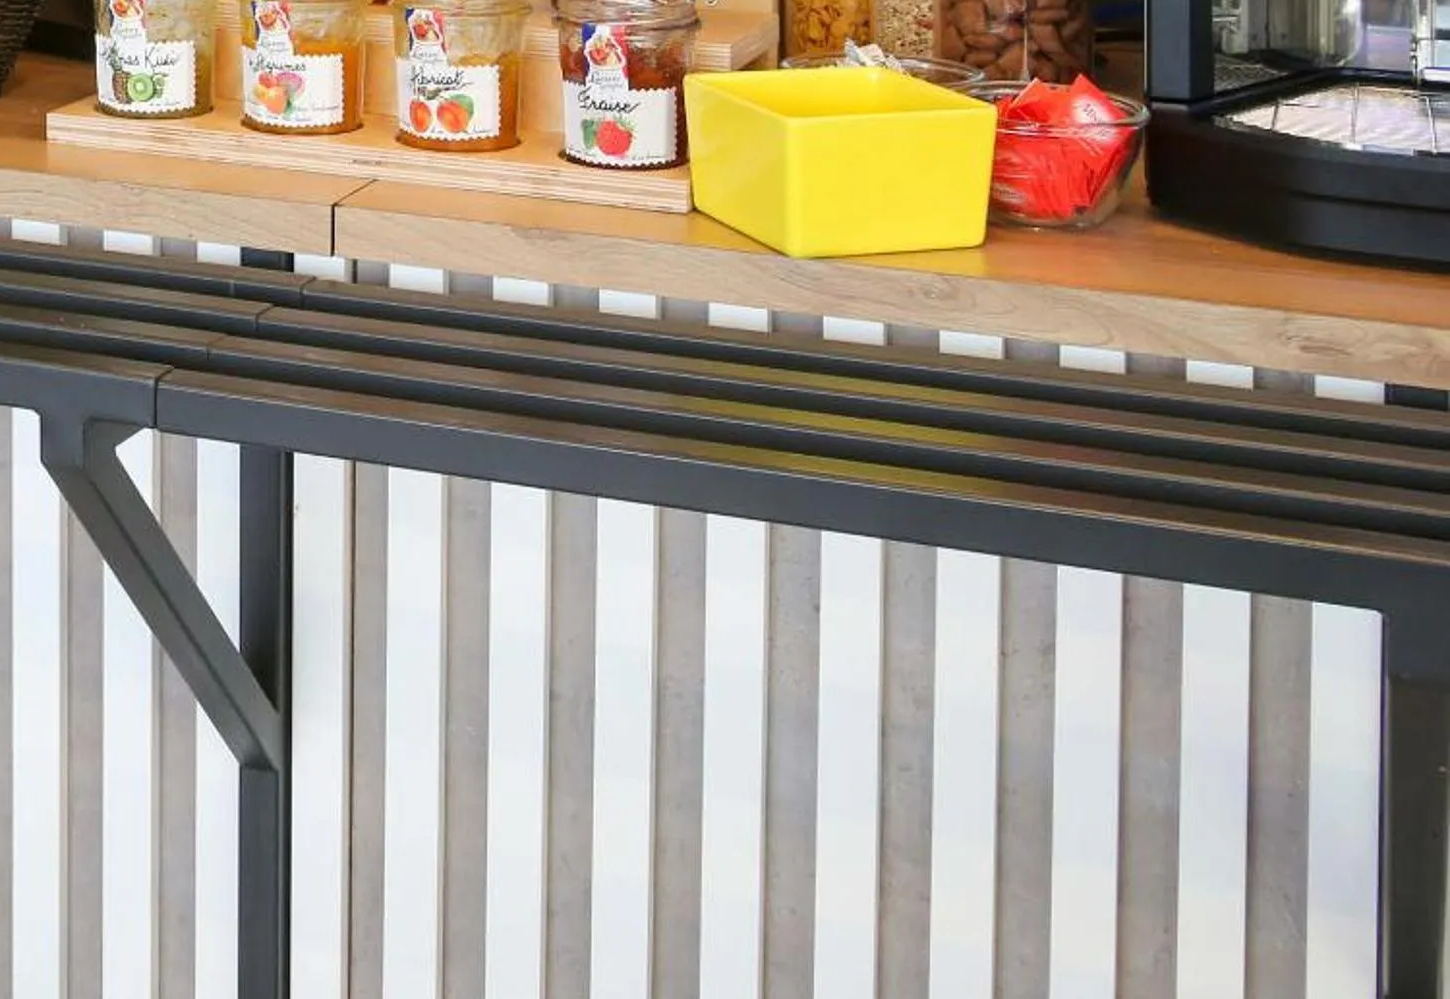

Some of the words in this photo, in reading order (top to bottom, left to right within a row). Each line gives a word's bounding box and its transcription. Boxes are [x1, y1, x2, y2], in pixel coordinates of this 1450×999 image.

[144, 45, 179, 69] Kiwi
[410, 64, 466, 87] Abricot
[577, 85, 642, 114] Fraise
